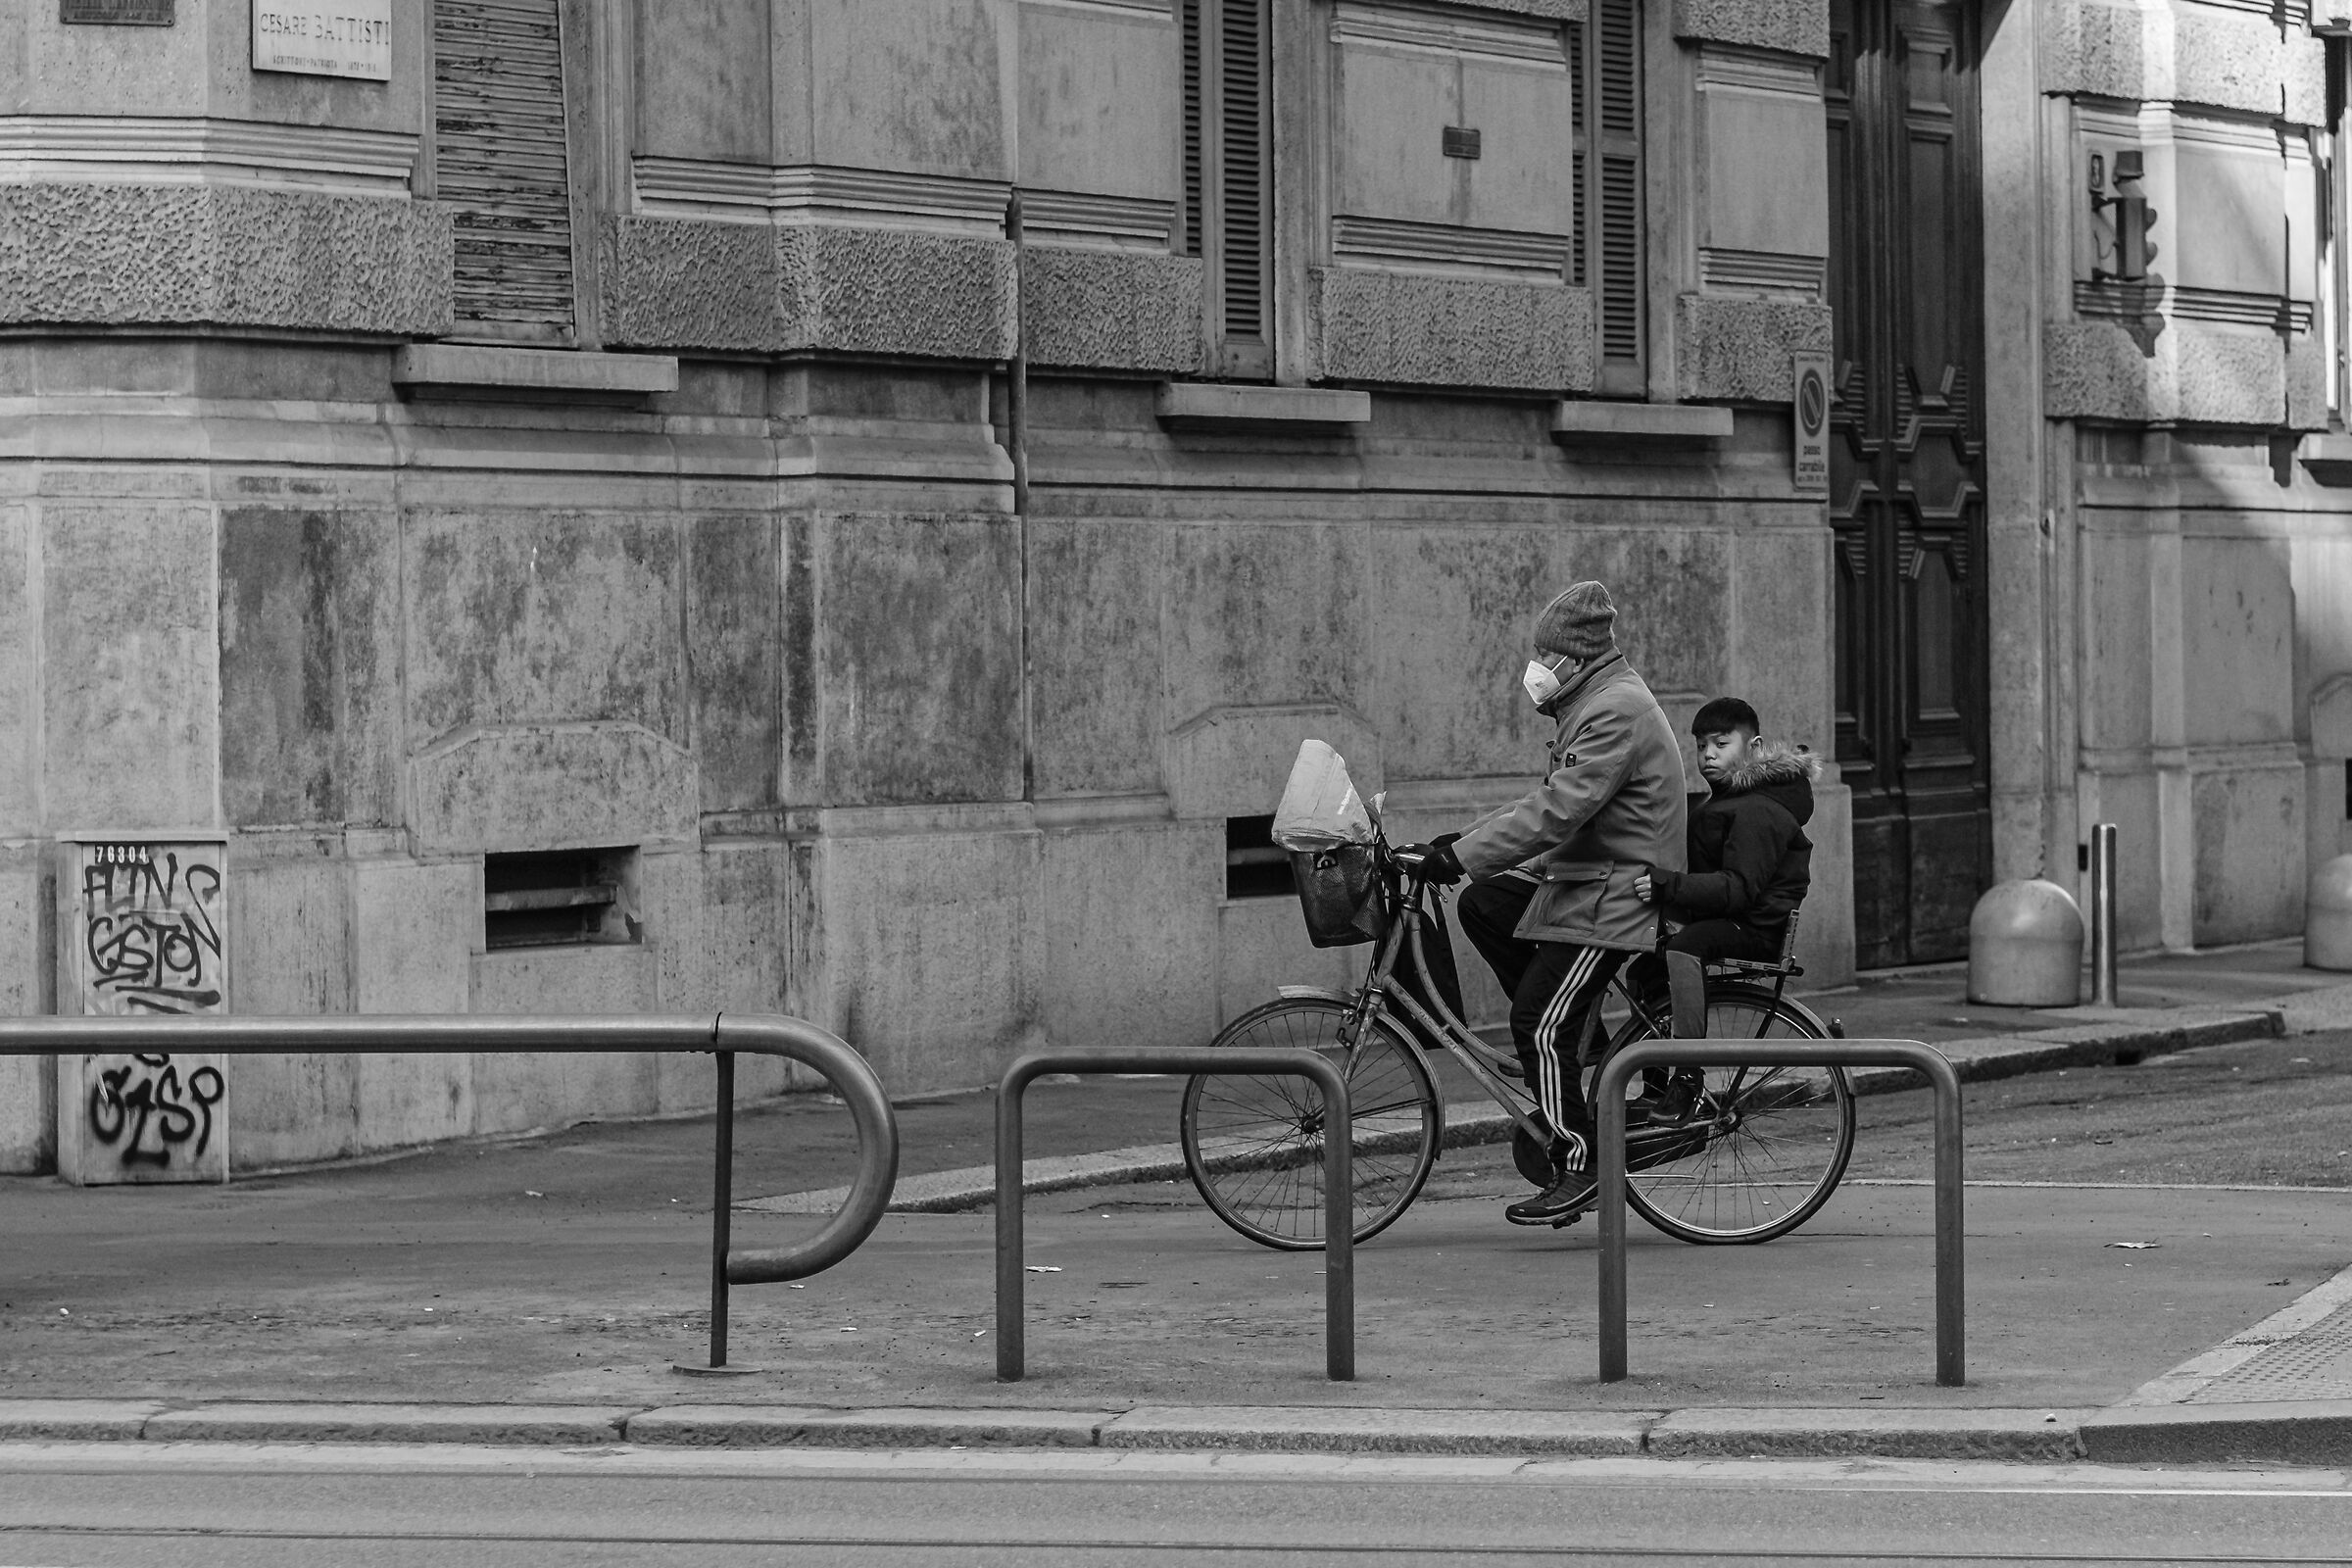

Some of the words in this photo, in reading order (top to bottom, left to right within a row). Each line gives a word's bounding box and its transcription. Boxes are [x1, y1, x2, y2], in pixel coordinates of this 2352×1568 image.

[260, 13, 307, 35] CESARE
[315, 15, 389, 45] BATTISTI
[96, 846, 149, 863] 76304
